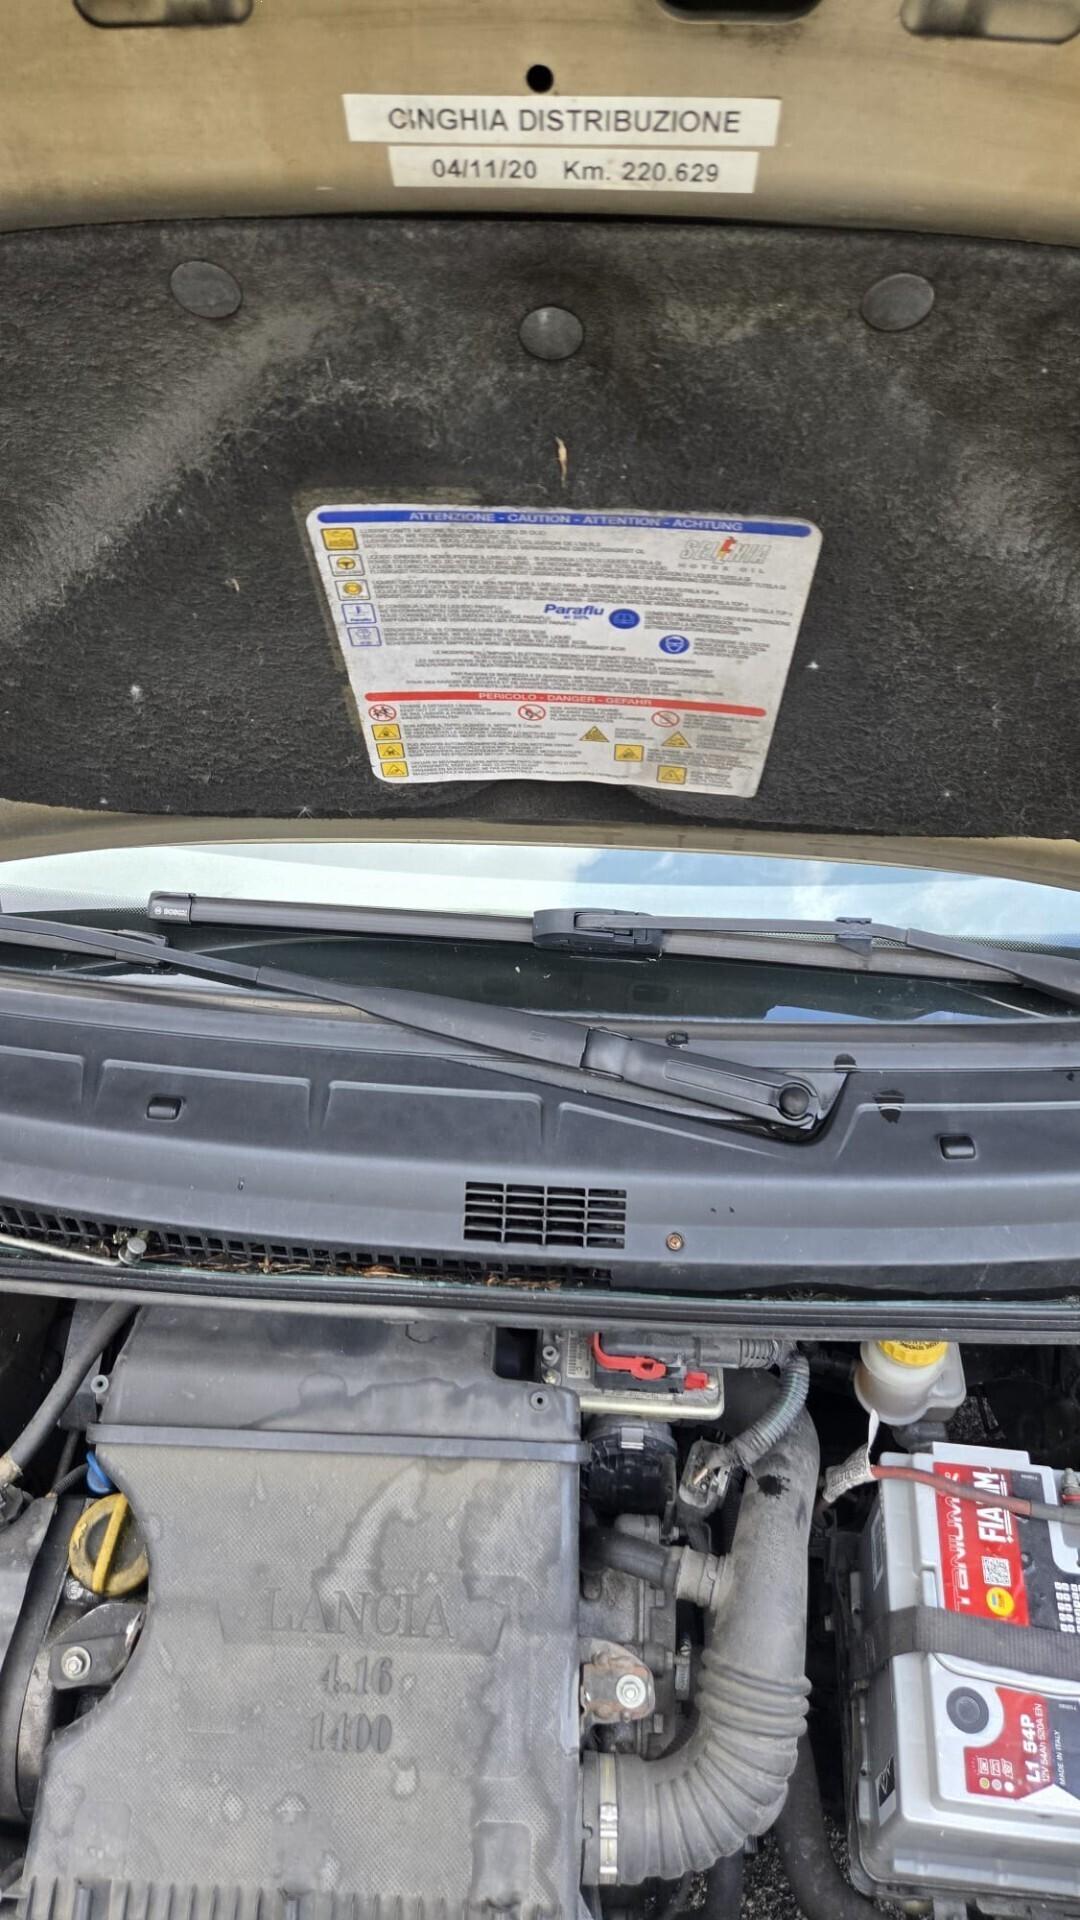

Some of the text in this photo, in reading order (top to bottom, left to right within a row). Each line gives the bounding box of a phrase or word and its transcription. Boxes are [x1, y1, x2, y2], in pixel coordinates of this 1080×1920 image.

[388, 107, 742, 134] CINGHIA DISTRIBUZIONE
[431, 158, 719, 183] 04/11/20 Km. 220.629
[408, 512, 743, 532] ATTENZIONE CAUTION ATTENTION ACHTUNG
[543, 603, 605, 617] Paraflu
[478, 692, 652, 706] PERICOLO DANGER GEFAHR
[257, 1586, 456, 1640] LANCIA
[308, 1711, 394, 1755] 1400
[1019, 1714, 1038, 1754] 54P
